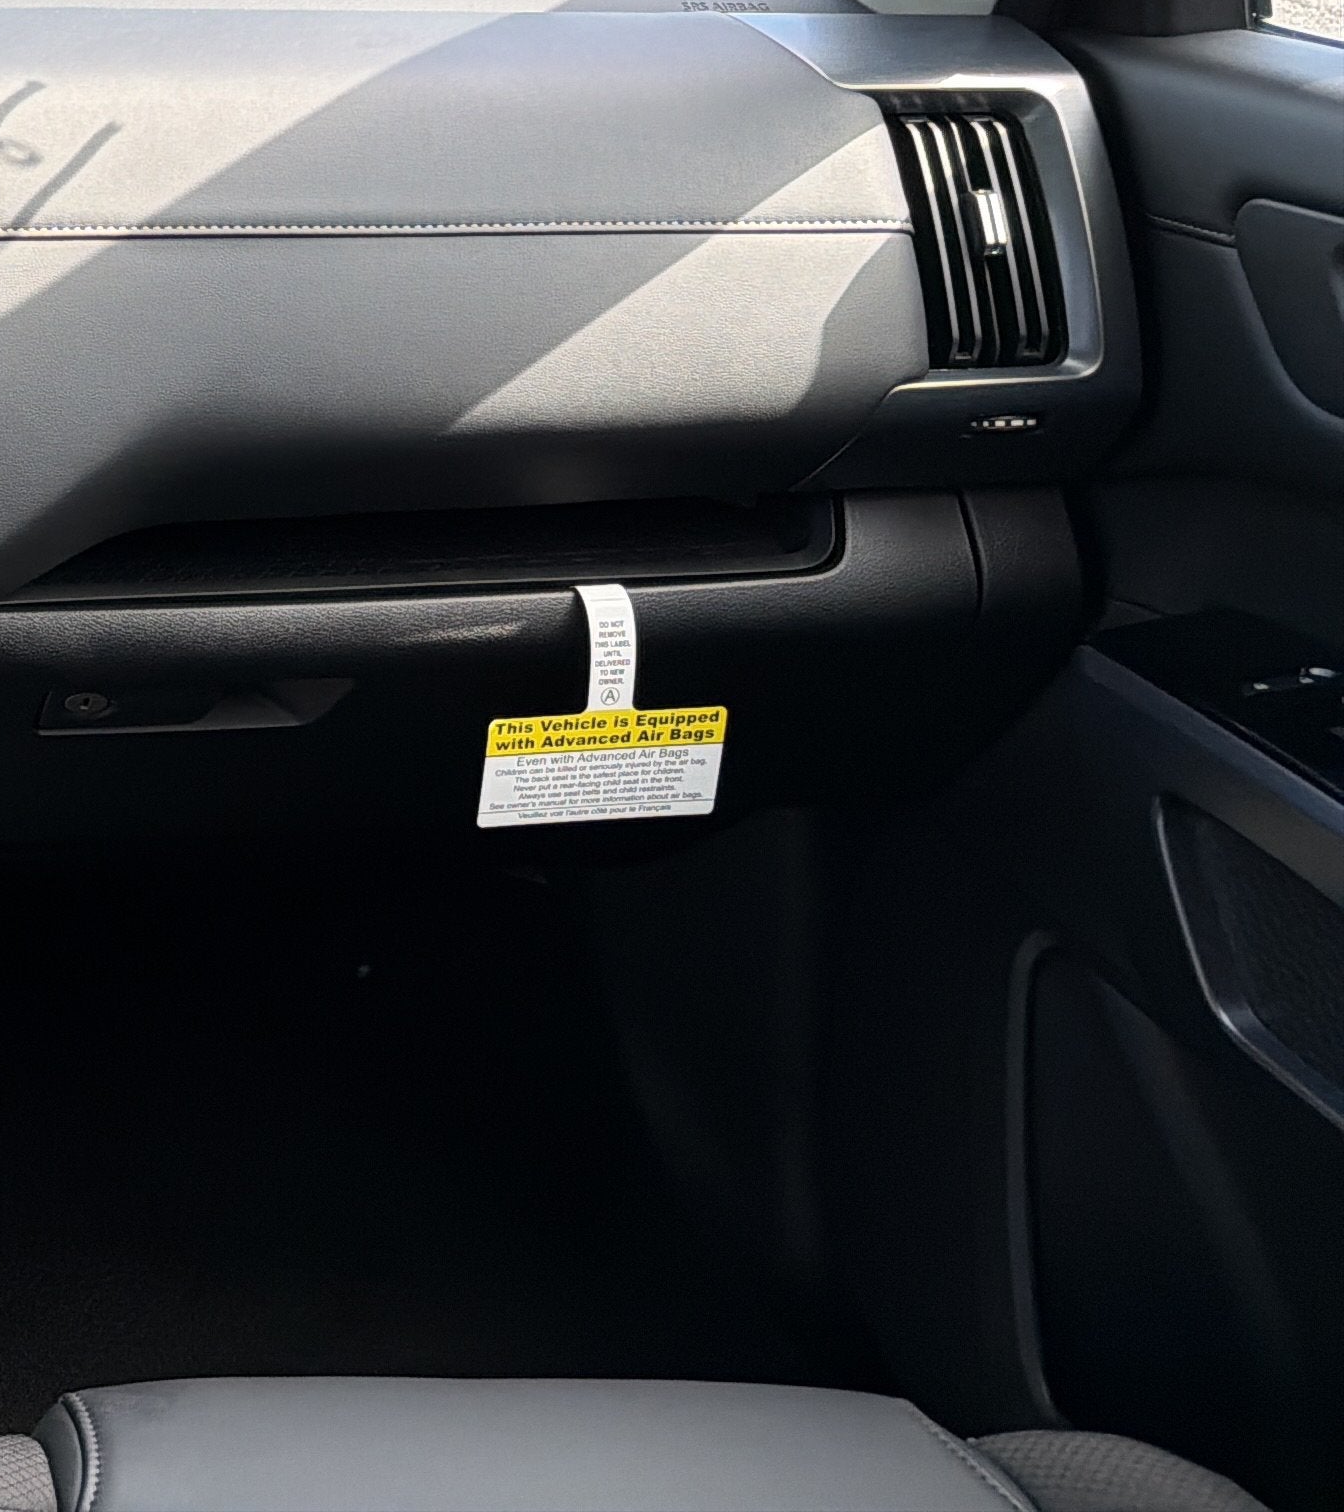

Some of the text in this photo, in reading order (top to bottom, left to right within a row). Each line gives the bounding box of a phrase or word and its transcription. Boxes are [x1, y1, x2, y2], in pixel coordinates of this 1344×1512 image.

[681, 1, 770, 13] SRS AIRBAG
[610, 620, 624, 628] NOT
[598, 630, 626, 638] REMOVE
[594, 659, 631, 667] DELIVERED
[495, 710, 720, 736] This Vehicle is Equipped
[496, 727, 715, 751] with Advanced Air Bags
[517, 748, 689, 767] Even with Advanced Air Bags
[495, 768, 527, 777] Children
[557, 764, 577, 772] killed
[625, 760, 651, 769] injured
[652, 760, 663, 768] by
[531, 775, 549, 783] back
[618, 770, 639, 778] place
[513, 784, 537, 792] Never
[538, 783, 552, 791] put
[602, 778, 621, 786] child
[622, 777, 640, 785] seat
[646, 792, 669, 801] about
